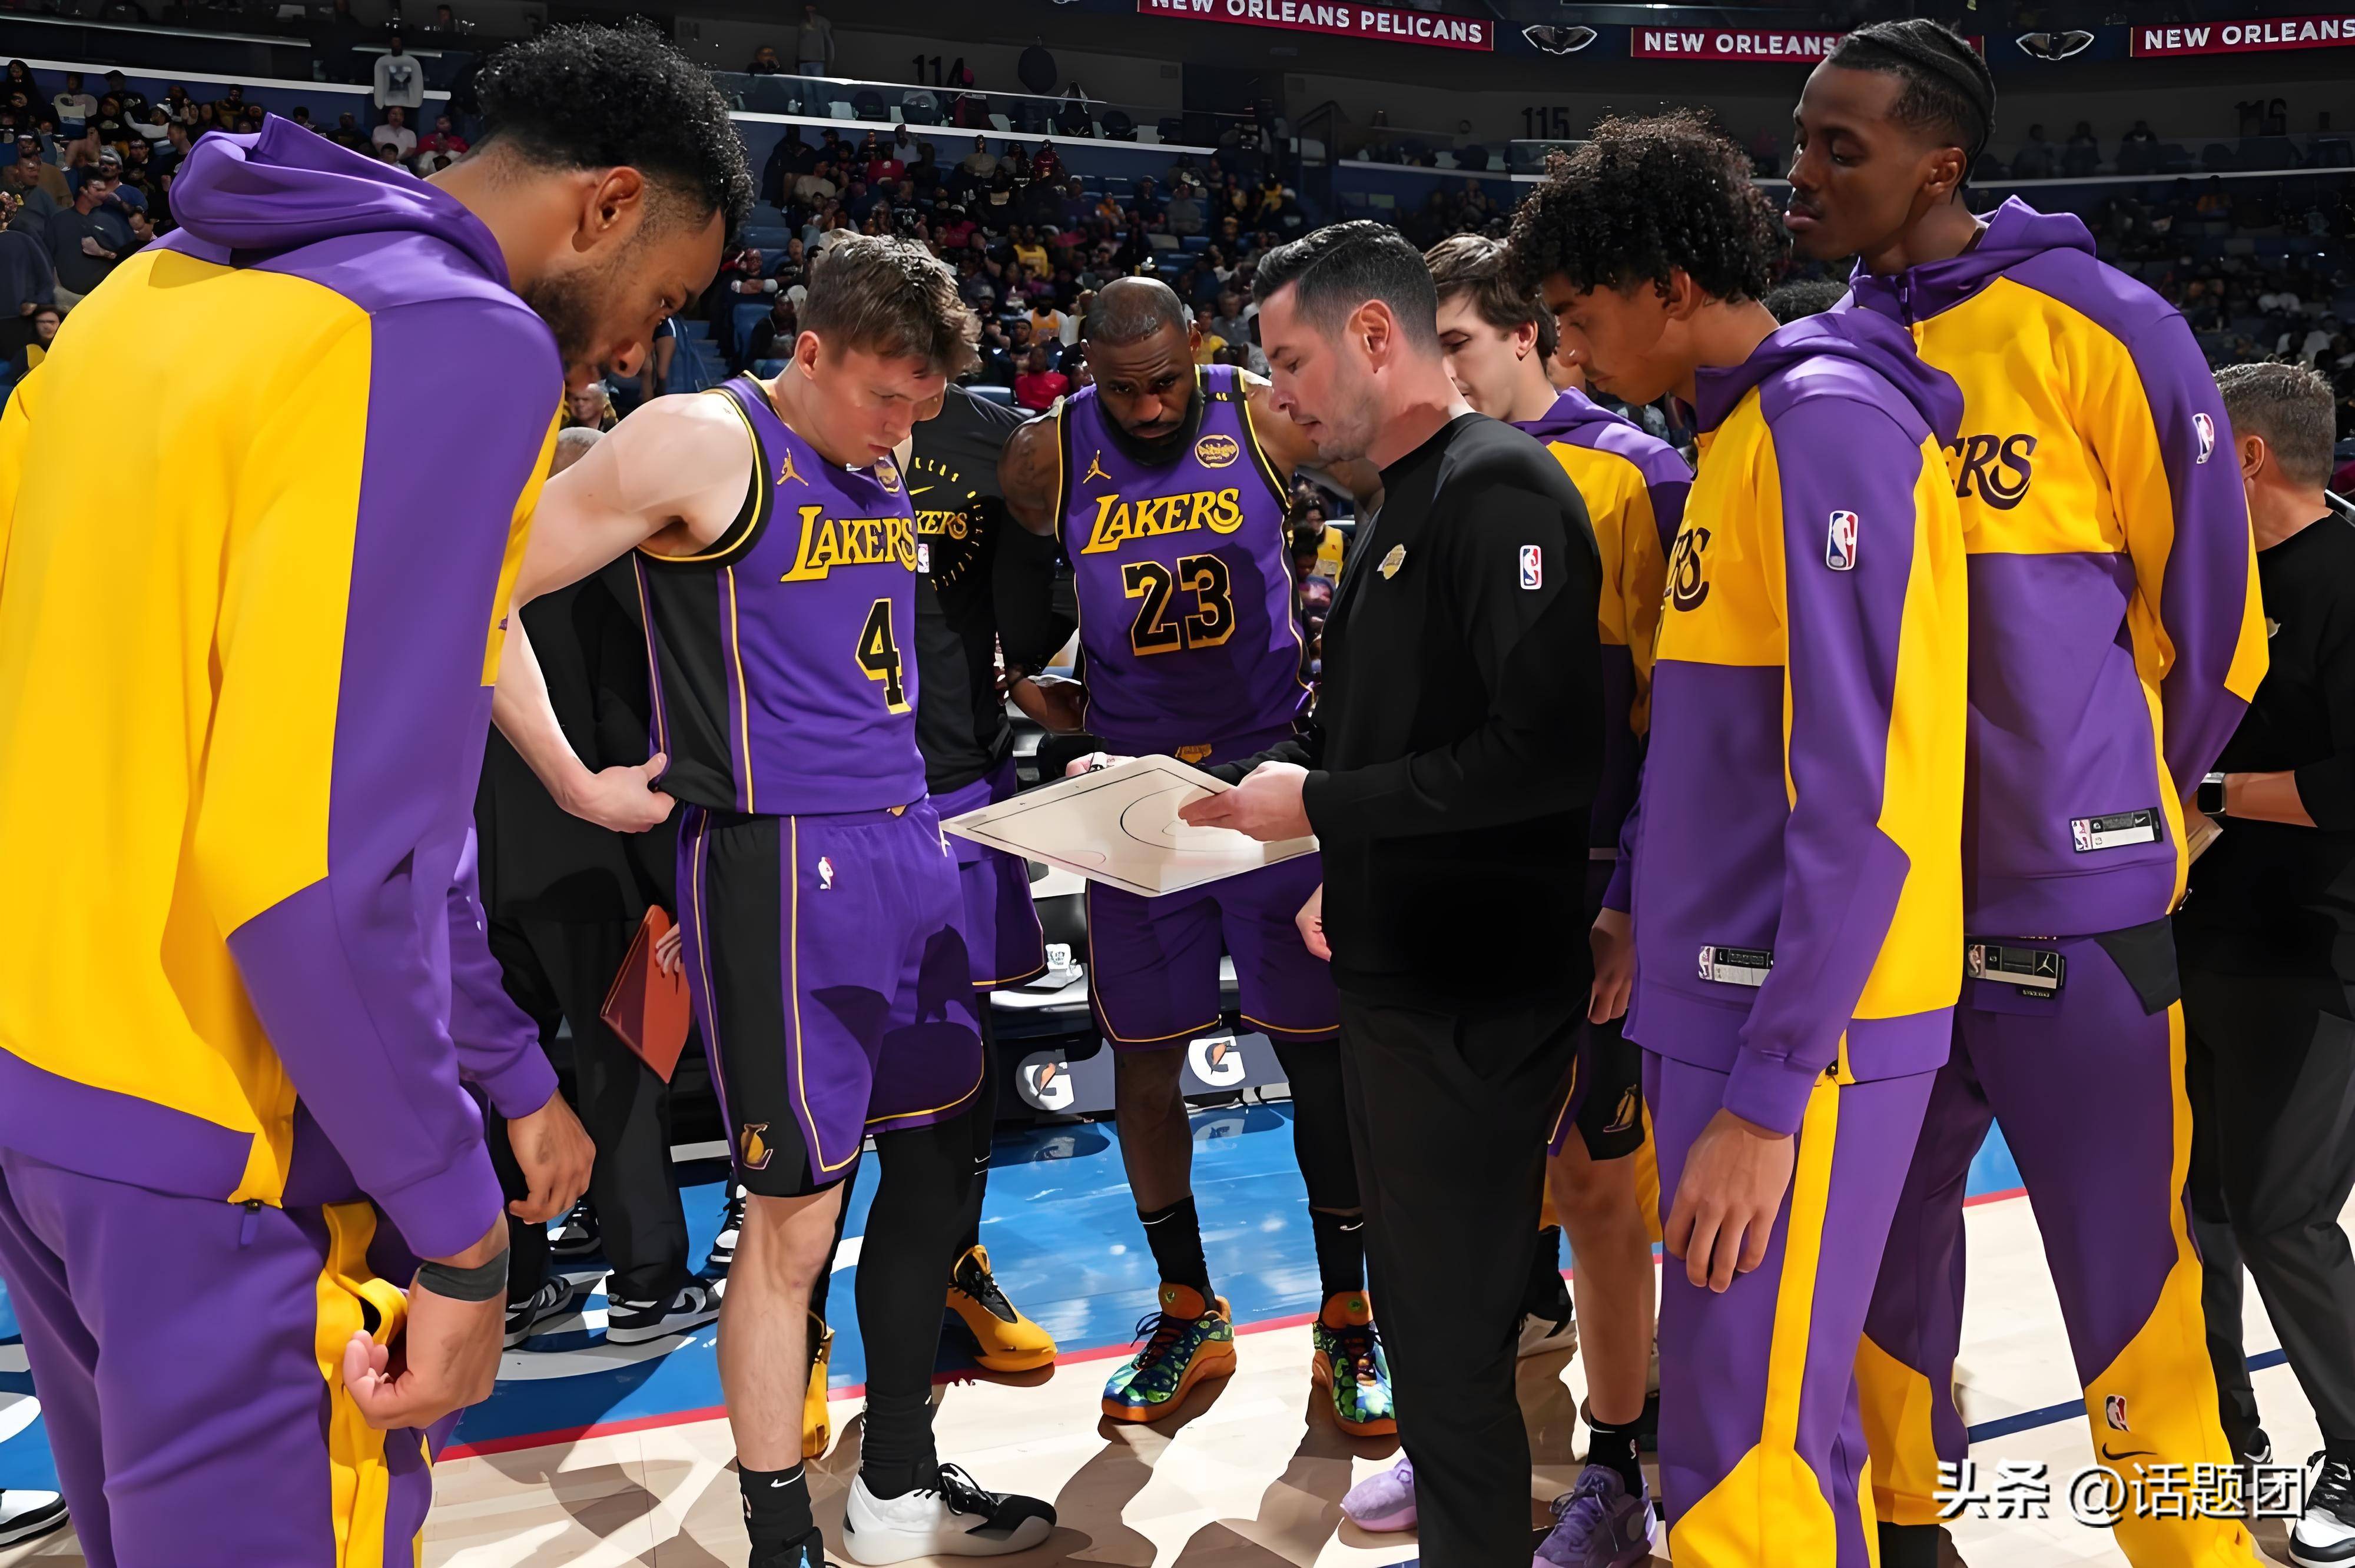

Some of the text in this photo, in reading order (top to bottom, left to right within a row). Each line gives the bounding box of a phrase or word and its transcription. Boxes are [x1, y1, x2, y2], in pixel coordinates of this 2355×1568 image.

[1227, 0, 1350, 28] ORLEANS
[1361, 11, 1482, 44] PELICANS
[1645, 32, 1704, 52] NEW
[2145, 19, 2355, 49] NEW ORLEANS
[780, 505, 918, 582] LAKERS
[1082, 488, 1243, 554] LAKERS
[1121, 554, 1235, 656] 23
[855, 597, 913, 715] 4
